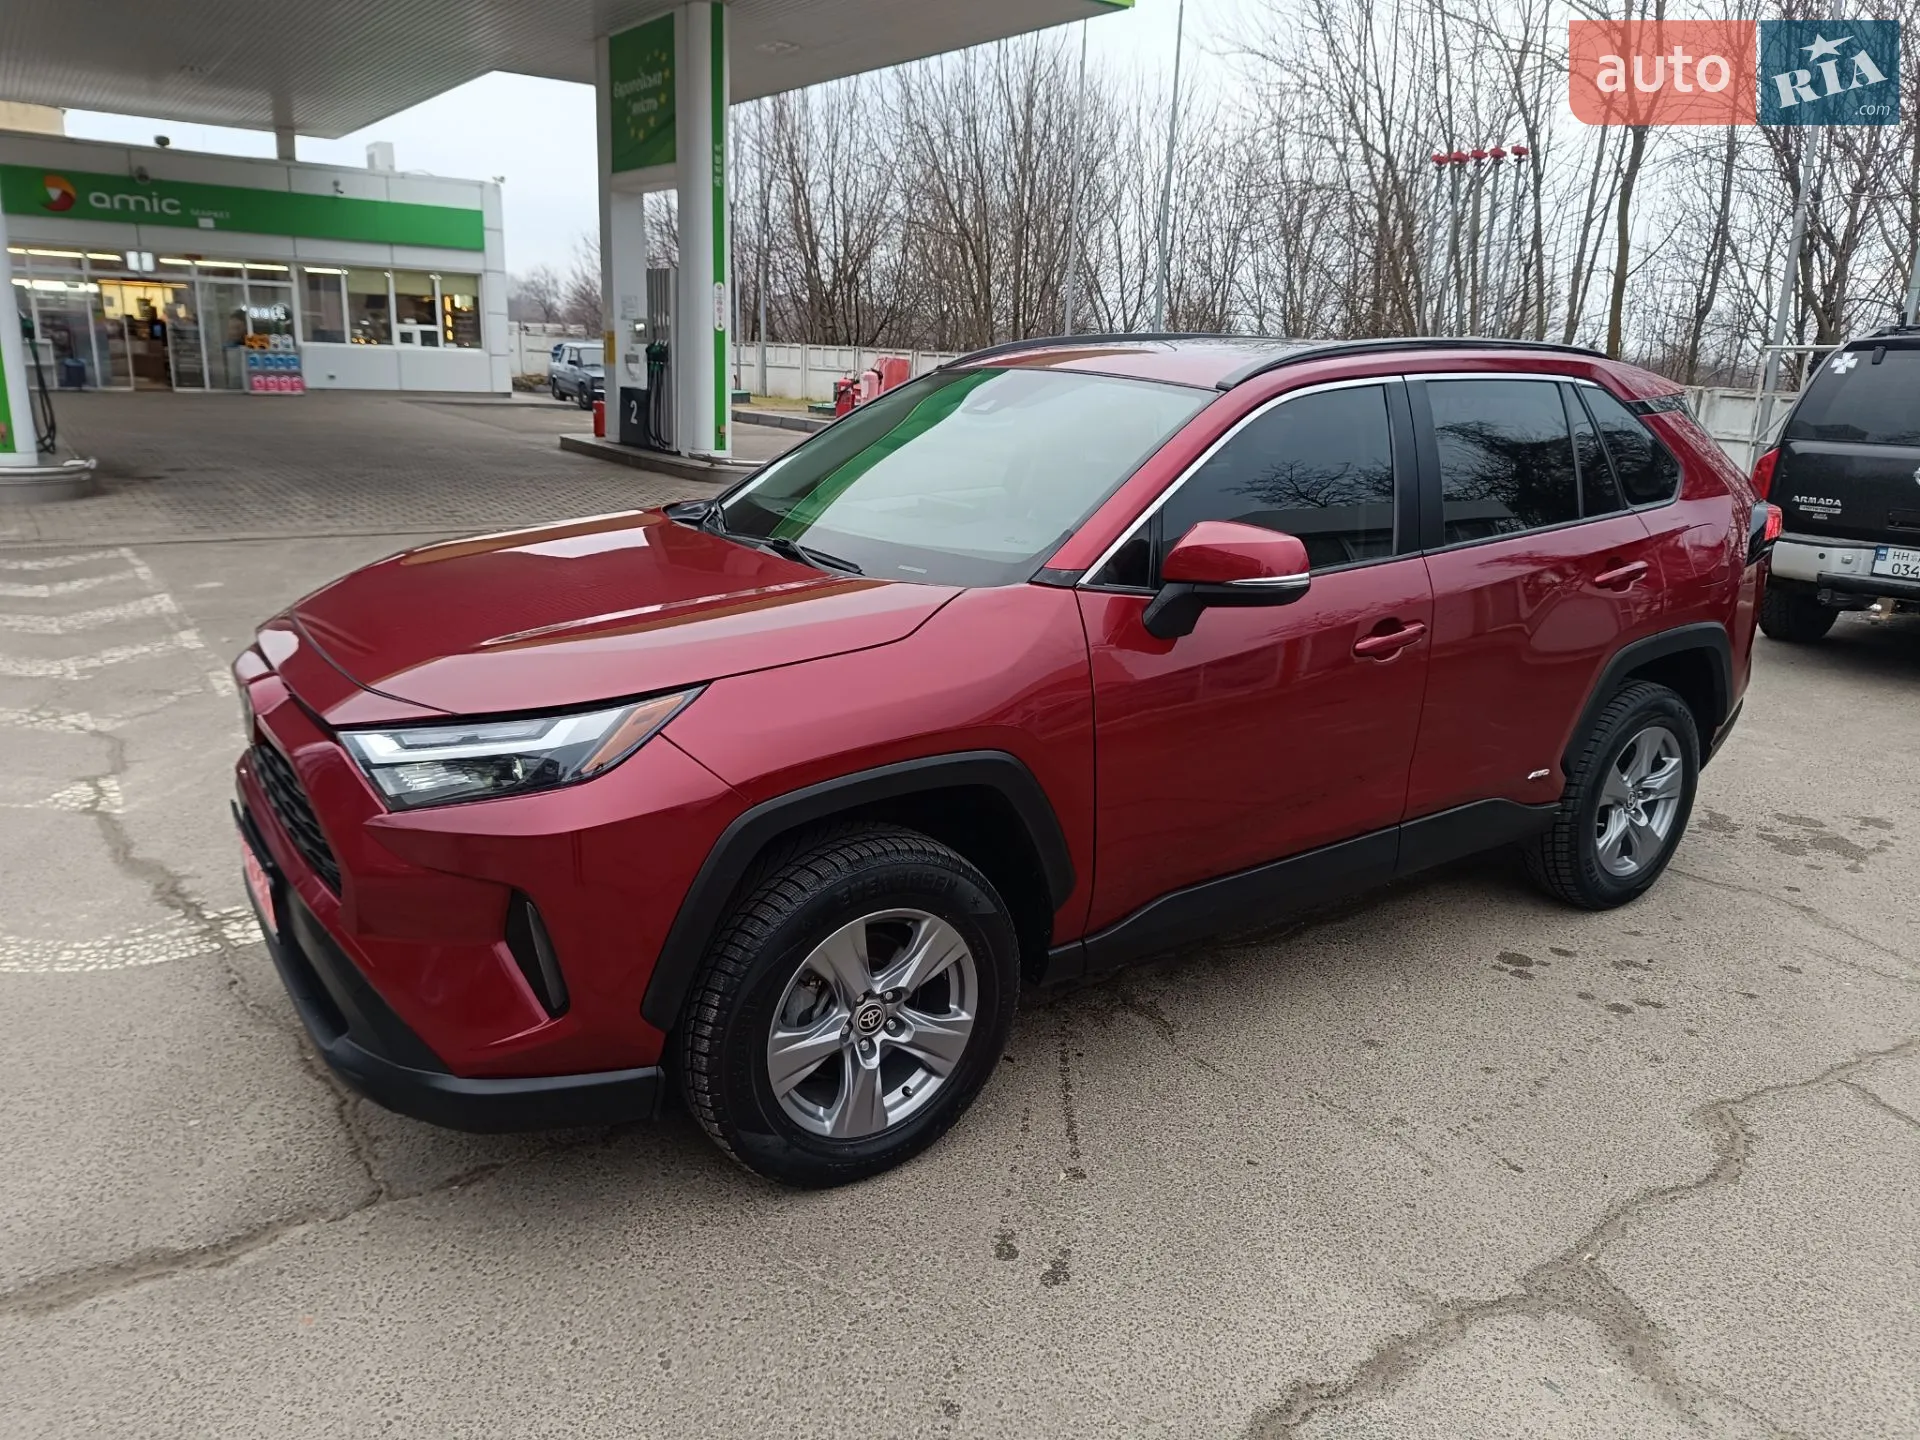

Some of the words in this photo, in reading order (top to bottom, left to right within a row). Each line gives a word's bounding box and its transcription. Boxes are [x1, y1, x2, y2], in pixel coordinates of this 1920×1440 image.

[88, 191, 182, 216] amic
[629, 399, 639, 425] 2
[1792, 495, 1842, 507] ARMADA
[1891, 563, 1920, 577] 034
